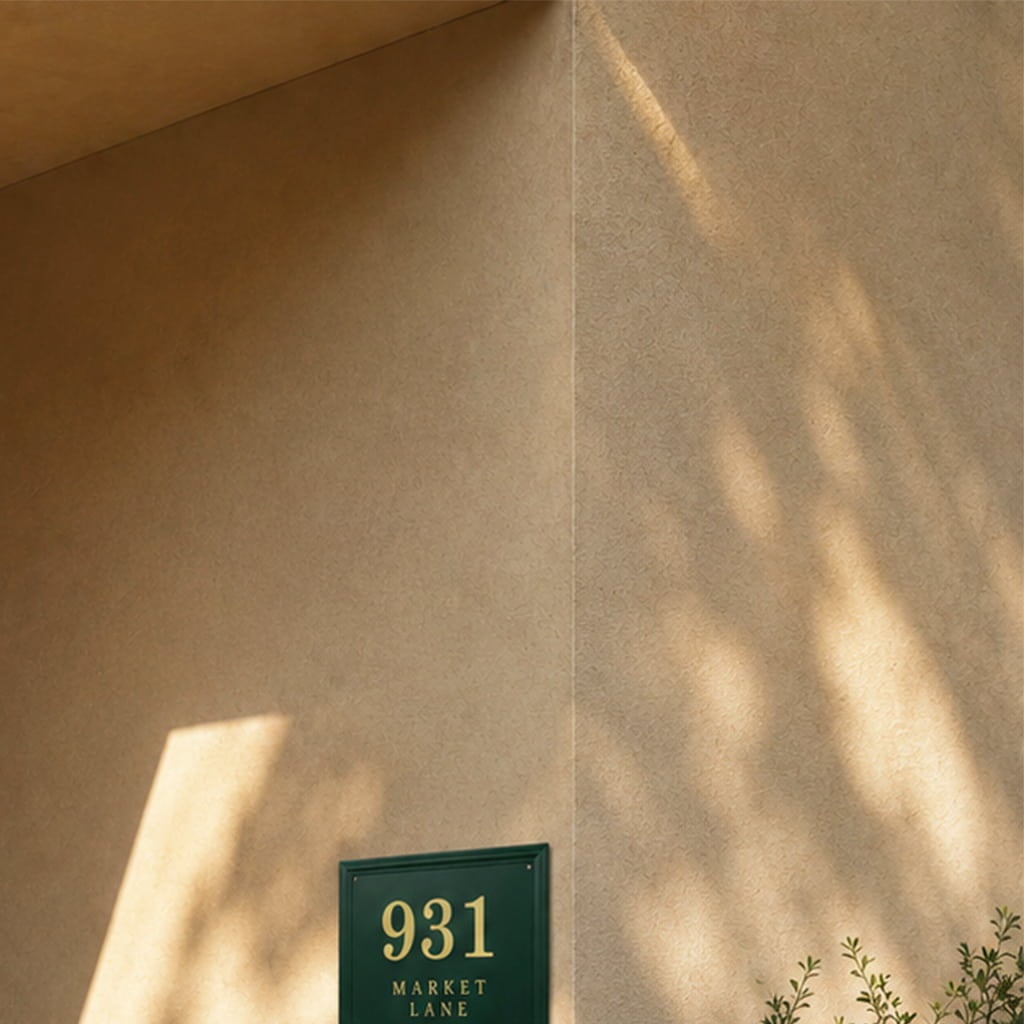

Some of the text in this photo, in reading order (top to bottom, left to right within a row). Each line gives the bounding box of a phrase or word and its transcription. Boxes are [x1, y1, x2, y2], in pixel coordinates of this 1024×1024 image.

[382, 895, 494, 961] 931
[392, 979, 487, 995] MARKET
[410, 1001, 468, 1017] LANE
